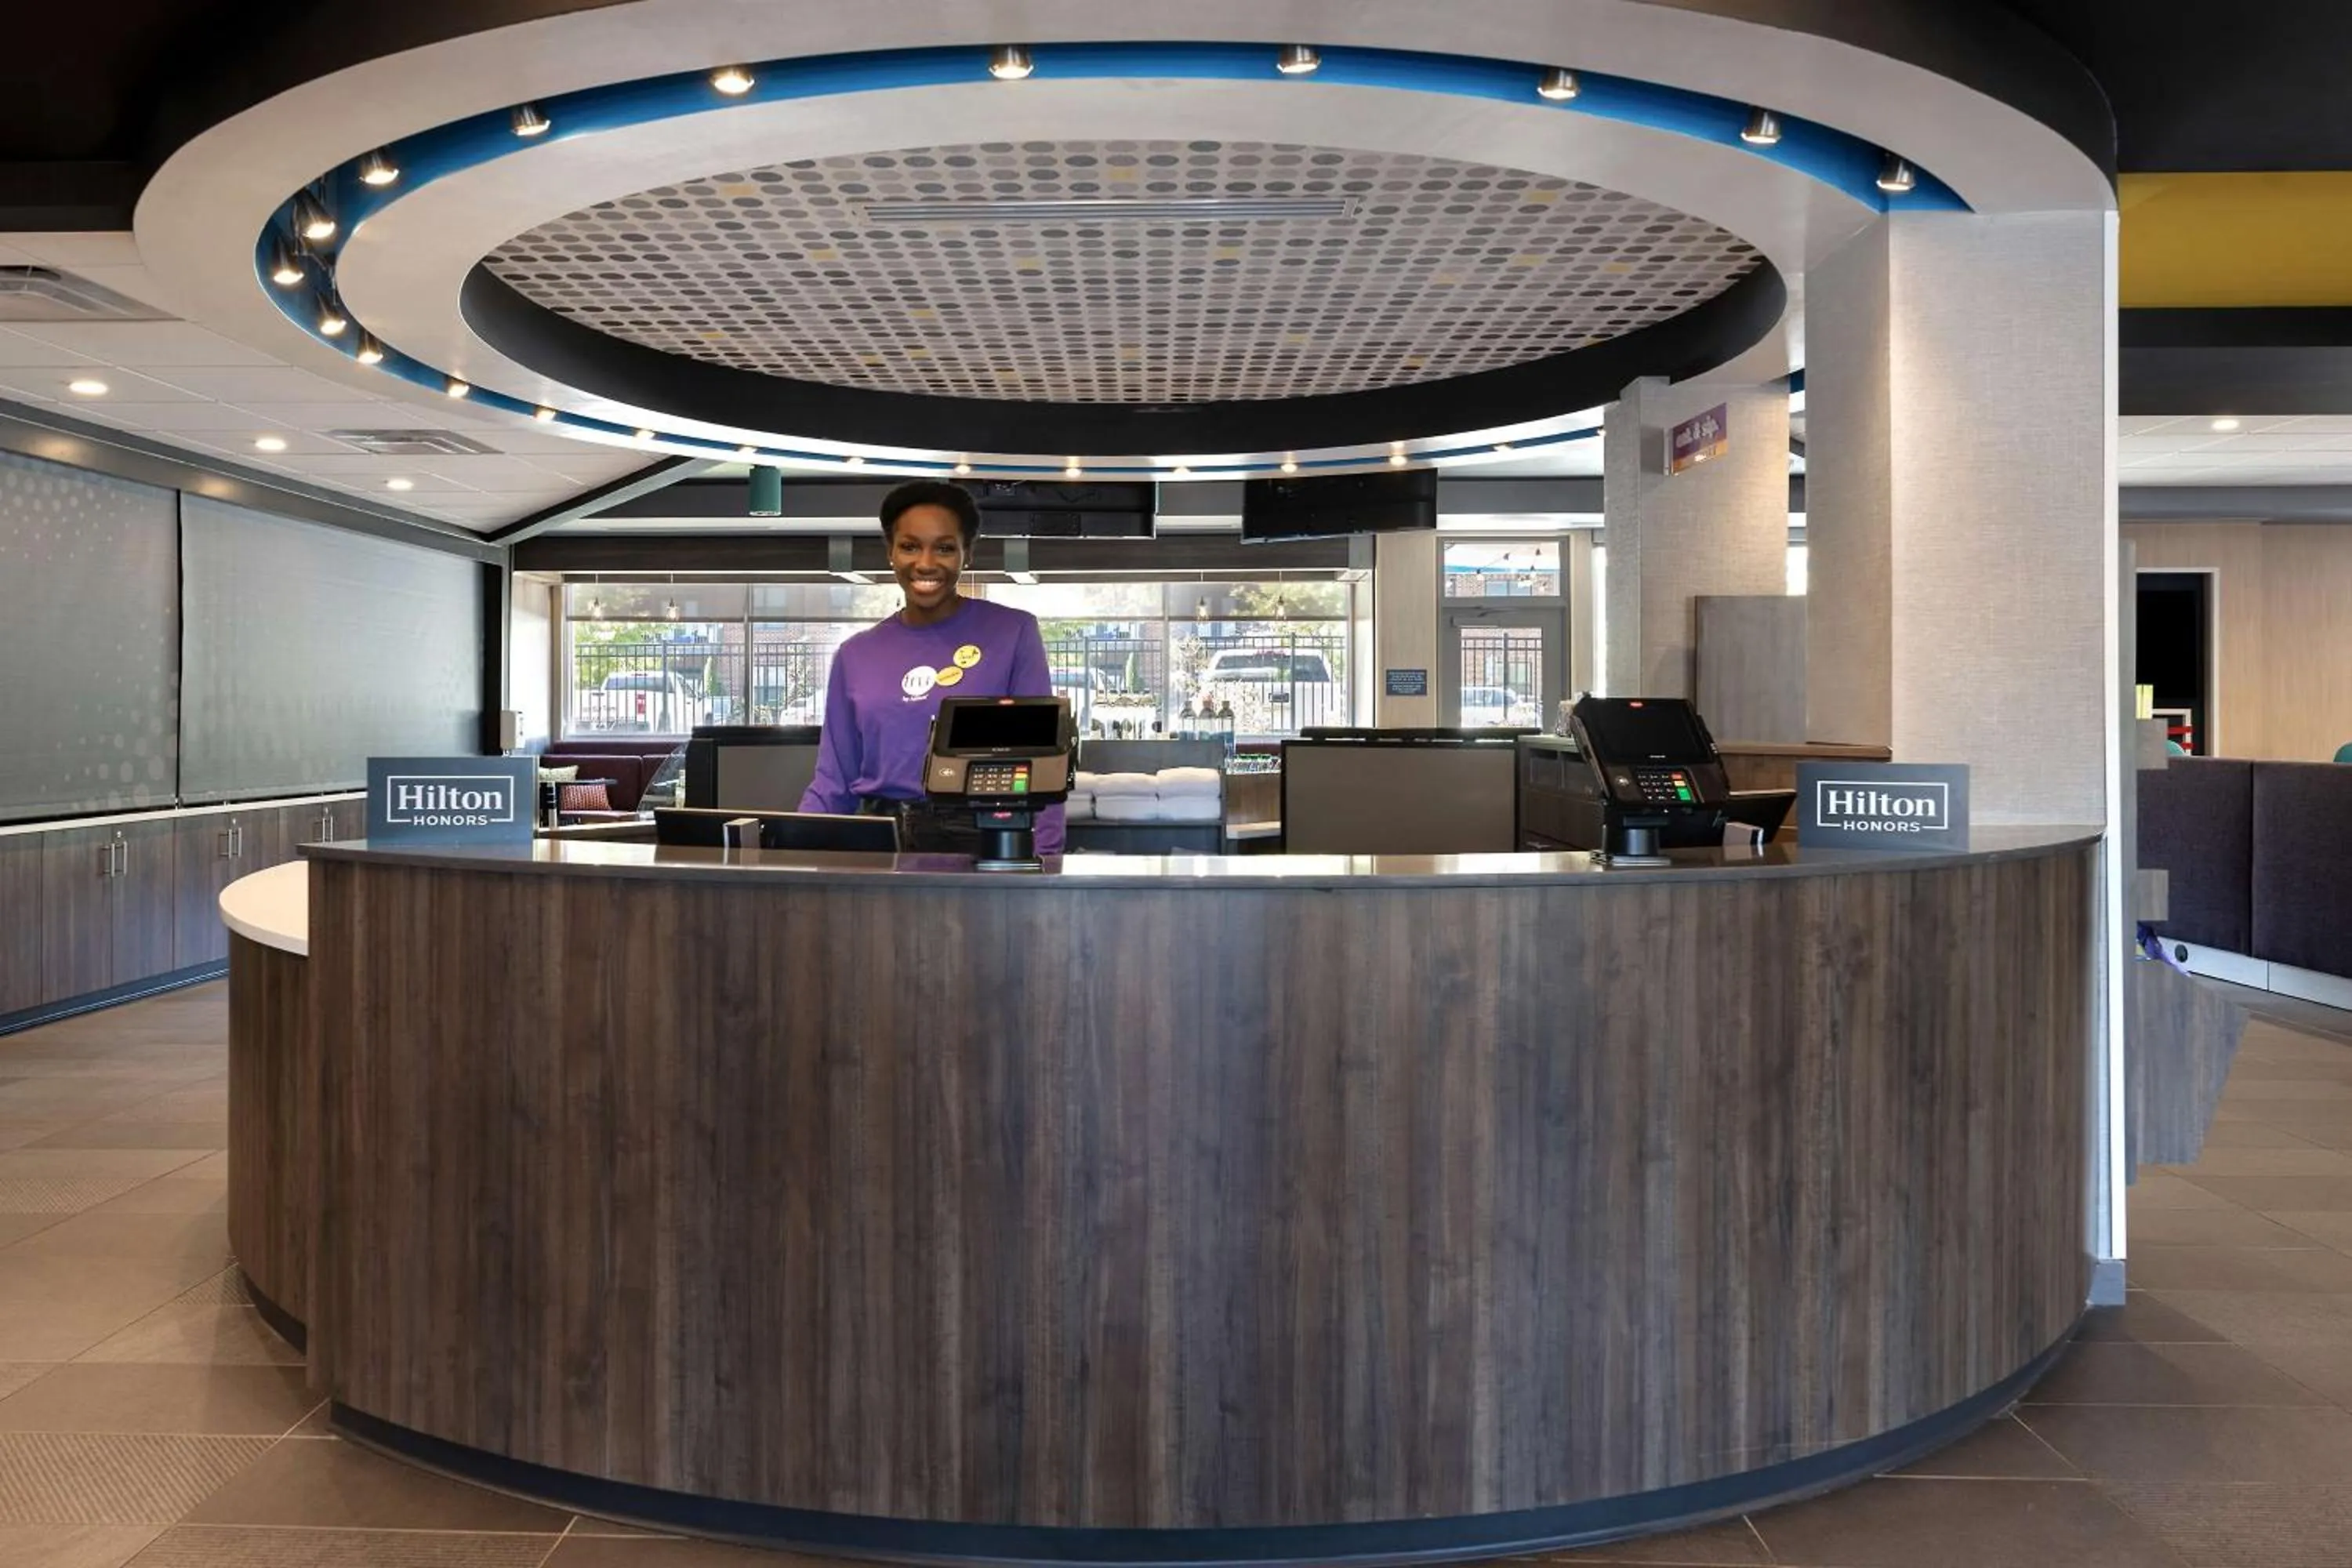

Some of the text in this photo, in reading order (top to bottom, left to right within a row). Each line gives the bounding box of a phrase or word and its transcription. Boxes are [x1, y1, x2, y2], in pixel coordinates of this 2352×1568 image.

[397, 785, 503, 810] Hilton
[1828, 790, 1936, 816] Hilton
[413, 815, 488, 826] HONORS
[1843, 821, 1920, 832] HONORS
